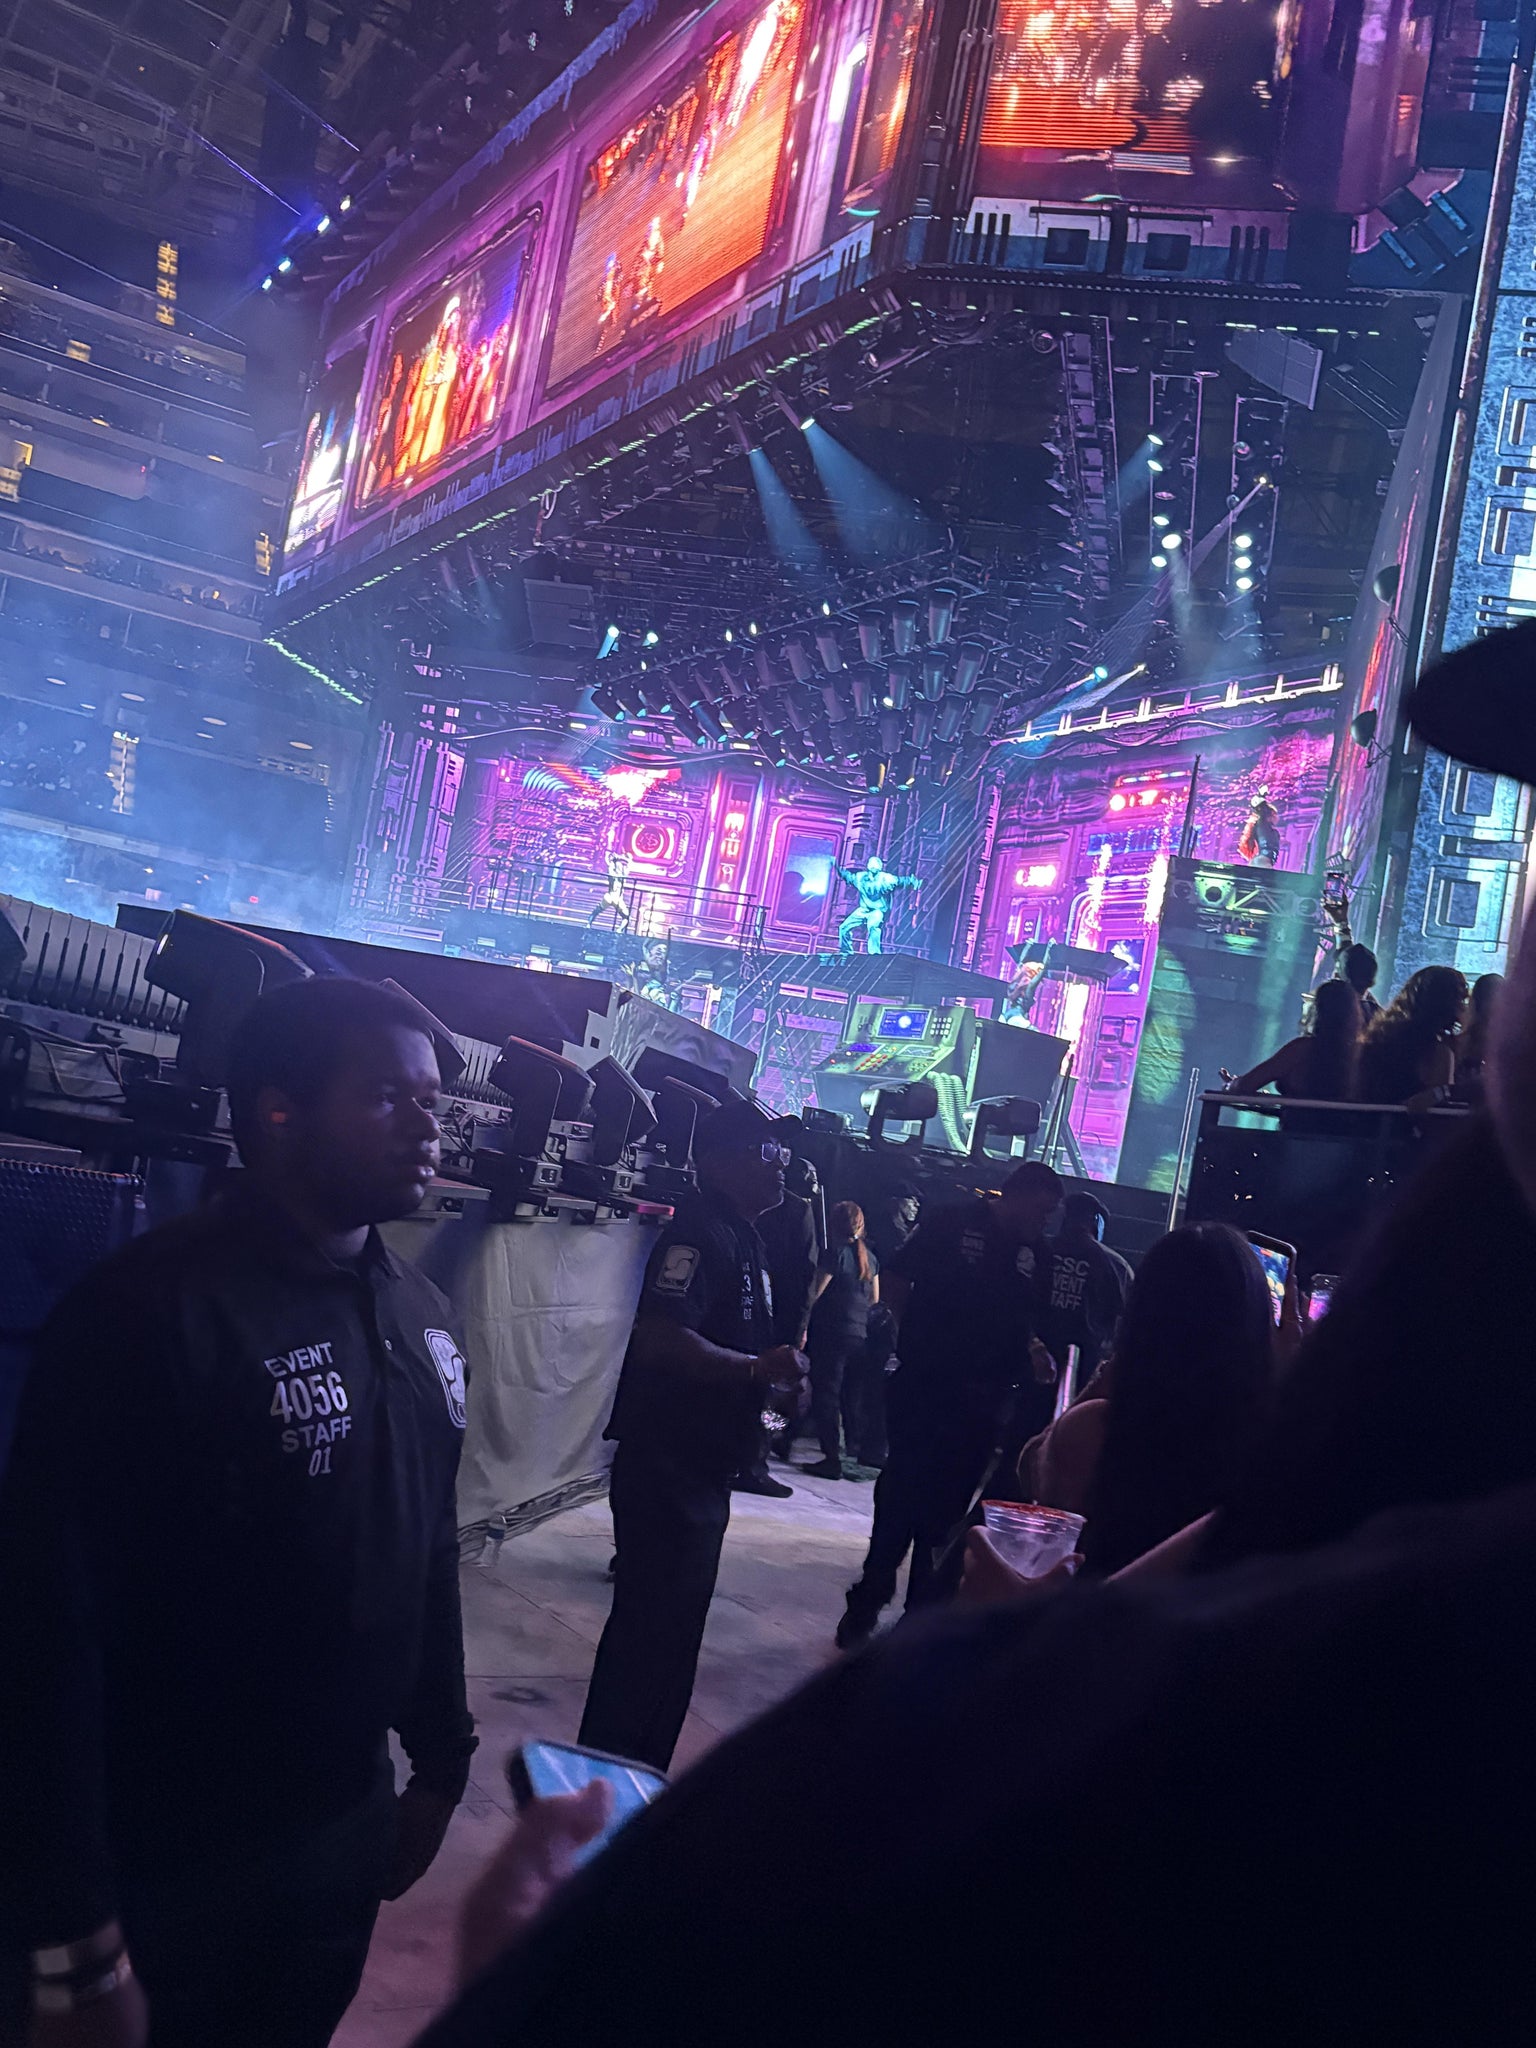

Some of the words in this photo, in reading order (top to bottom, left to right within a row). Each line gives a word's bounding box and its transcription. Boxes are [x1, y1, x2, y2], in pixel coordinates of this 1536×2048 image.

[1053, 1272, 1086, 1294] VENT
[1050, 1290, 1082, 1310] TAFF
[264, 1342, 333, 1378] EVENT
[270, 1371, 348, 1423] 4056
[281, 1416, 352, 1453] STAFF
[308, 1447, 331, 1477] 01
